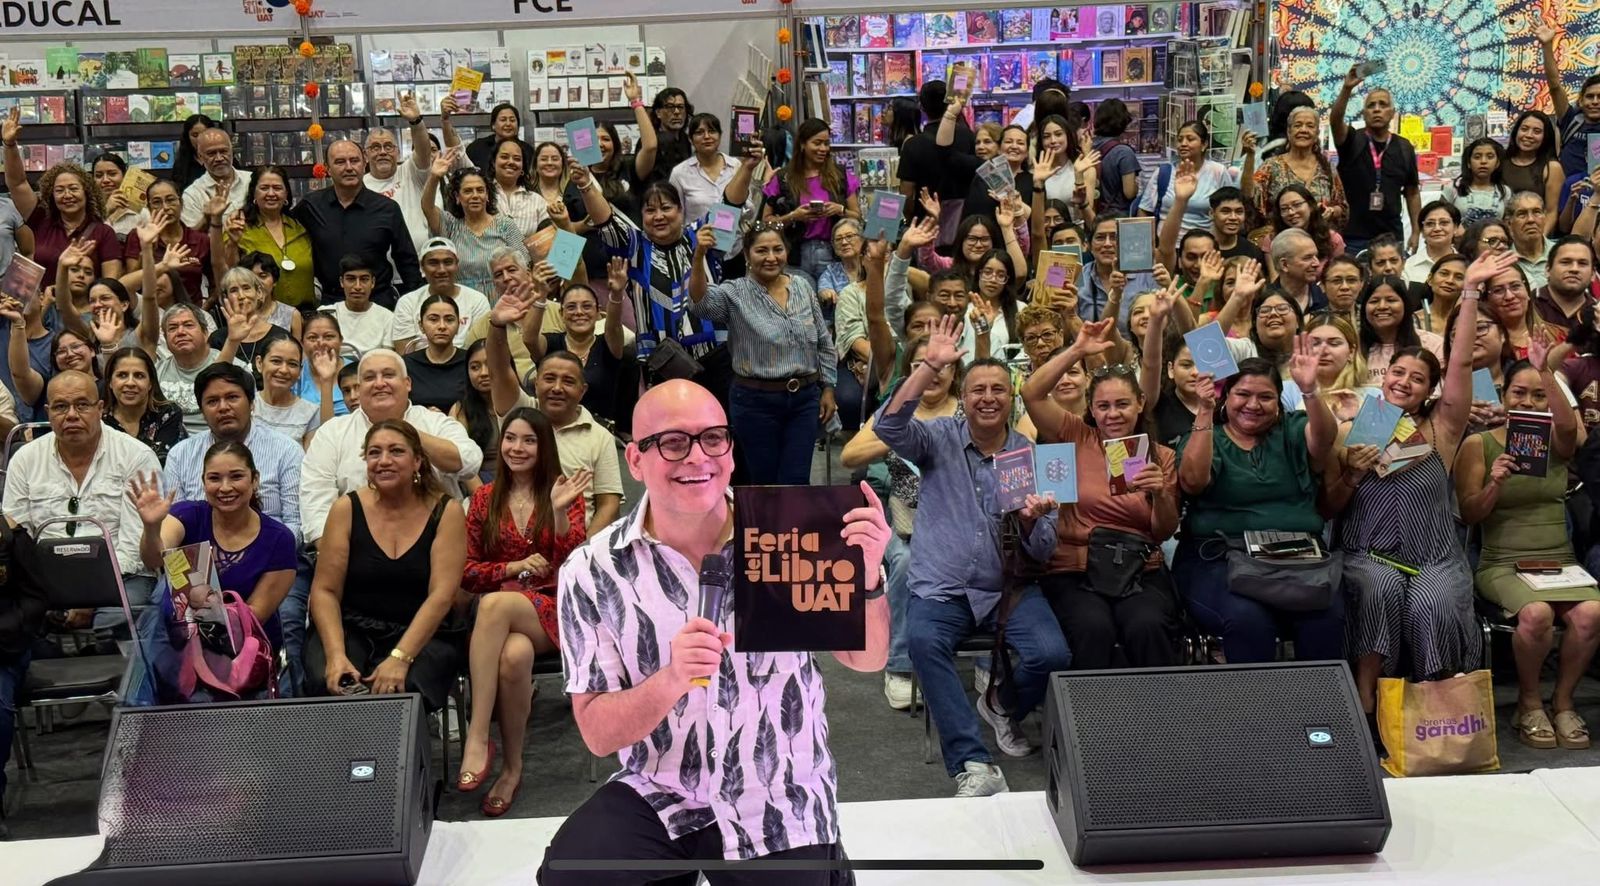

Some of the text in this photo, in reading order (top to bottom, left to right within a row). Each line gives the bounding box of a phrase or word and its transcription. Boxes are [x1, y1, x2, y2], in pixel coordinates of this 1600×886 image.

[0, 0, 121, 27] DUCAL
[256, 14, 274, 22] UAT
[744, 527, 819, 552] Feria
[744, 553, 761, 582] del
[762, 552, 855, 582] Libro
[791, 583, 855, 612] UAT
